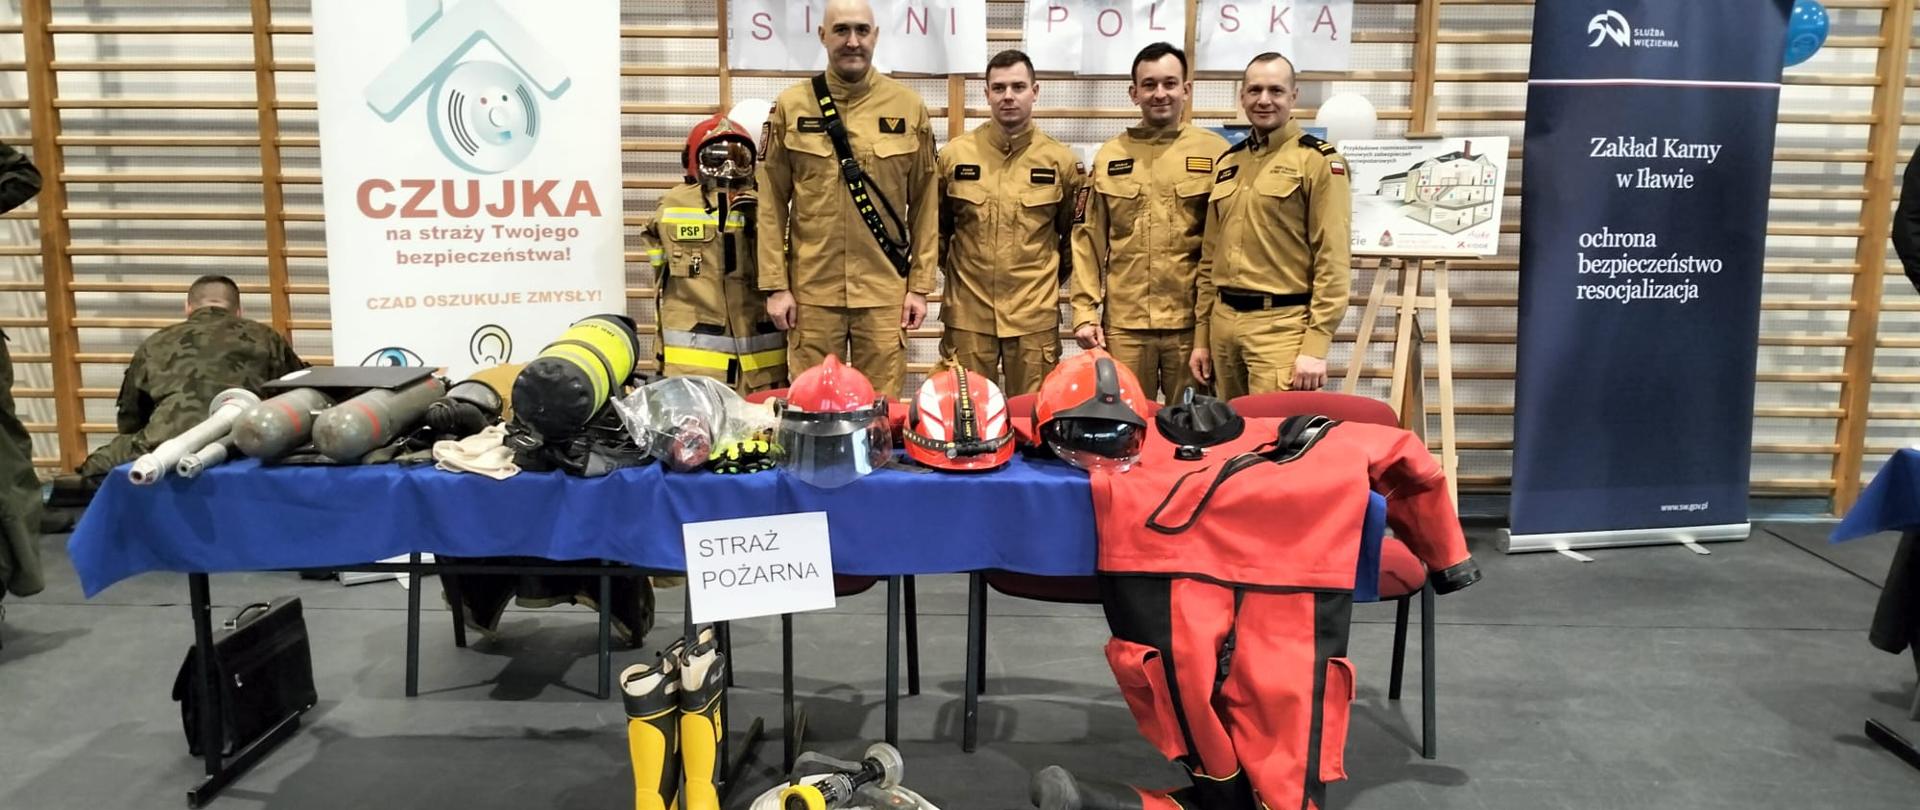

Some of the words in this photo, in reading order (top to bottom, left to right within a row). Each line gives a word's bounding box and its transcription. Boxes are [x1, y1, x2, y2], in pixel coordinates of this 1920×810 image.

[751, 5, 956, 41] SINI
[1634, 28, 1665, 37] SŁUŻBA
[1634, 39, 1679, 48] WIĘZIENNA
[1590, 136, 1658, 158] Zakład
[1663, 138, 1722, 164] Karny
[1616, 173, 1633, 188] w
[1635, 167, 1694, 188] Iławie
[356, 178, 603, 219] CZUJKA
[386, 229, 412, 241] na
[419, 224, 485, 243] straży
[491, 224, 579, 242] Twojego
[680, 226, 700, 236] PSP
[1578, 226, 1657, 248] ochrona
[396, 247, 571, 267] bezpieczeństwa!
[1577, 252, 1723, 279] bezpieczeństwo
[366, 296, 417, 310] CZAD
[423, 292, 522, 307] OSZUKUJE
[527, 289, 603, 303] ZMYSŁY!
[1576, 278, 1699, 304] resocjalizacja
[698, 529, 780, 558] STRAŻ
[701, 561, 820, 590] POŻARNA
